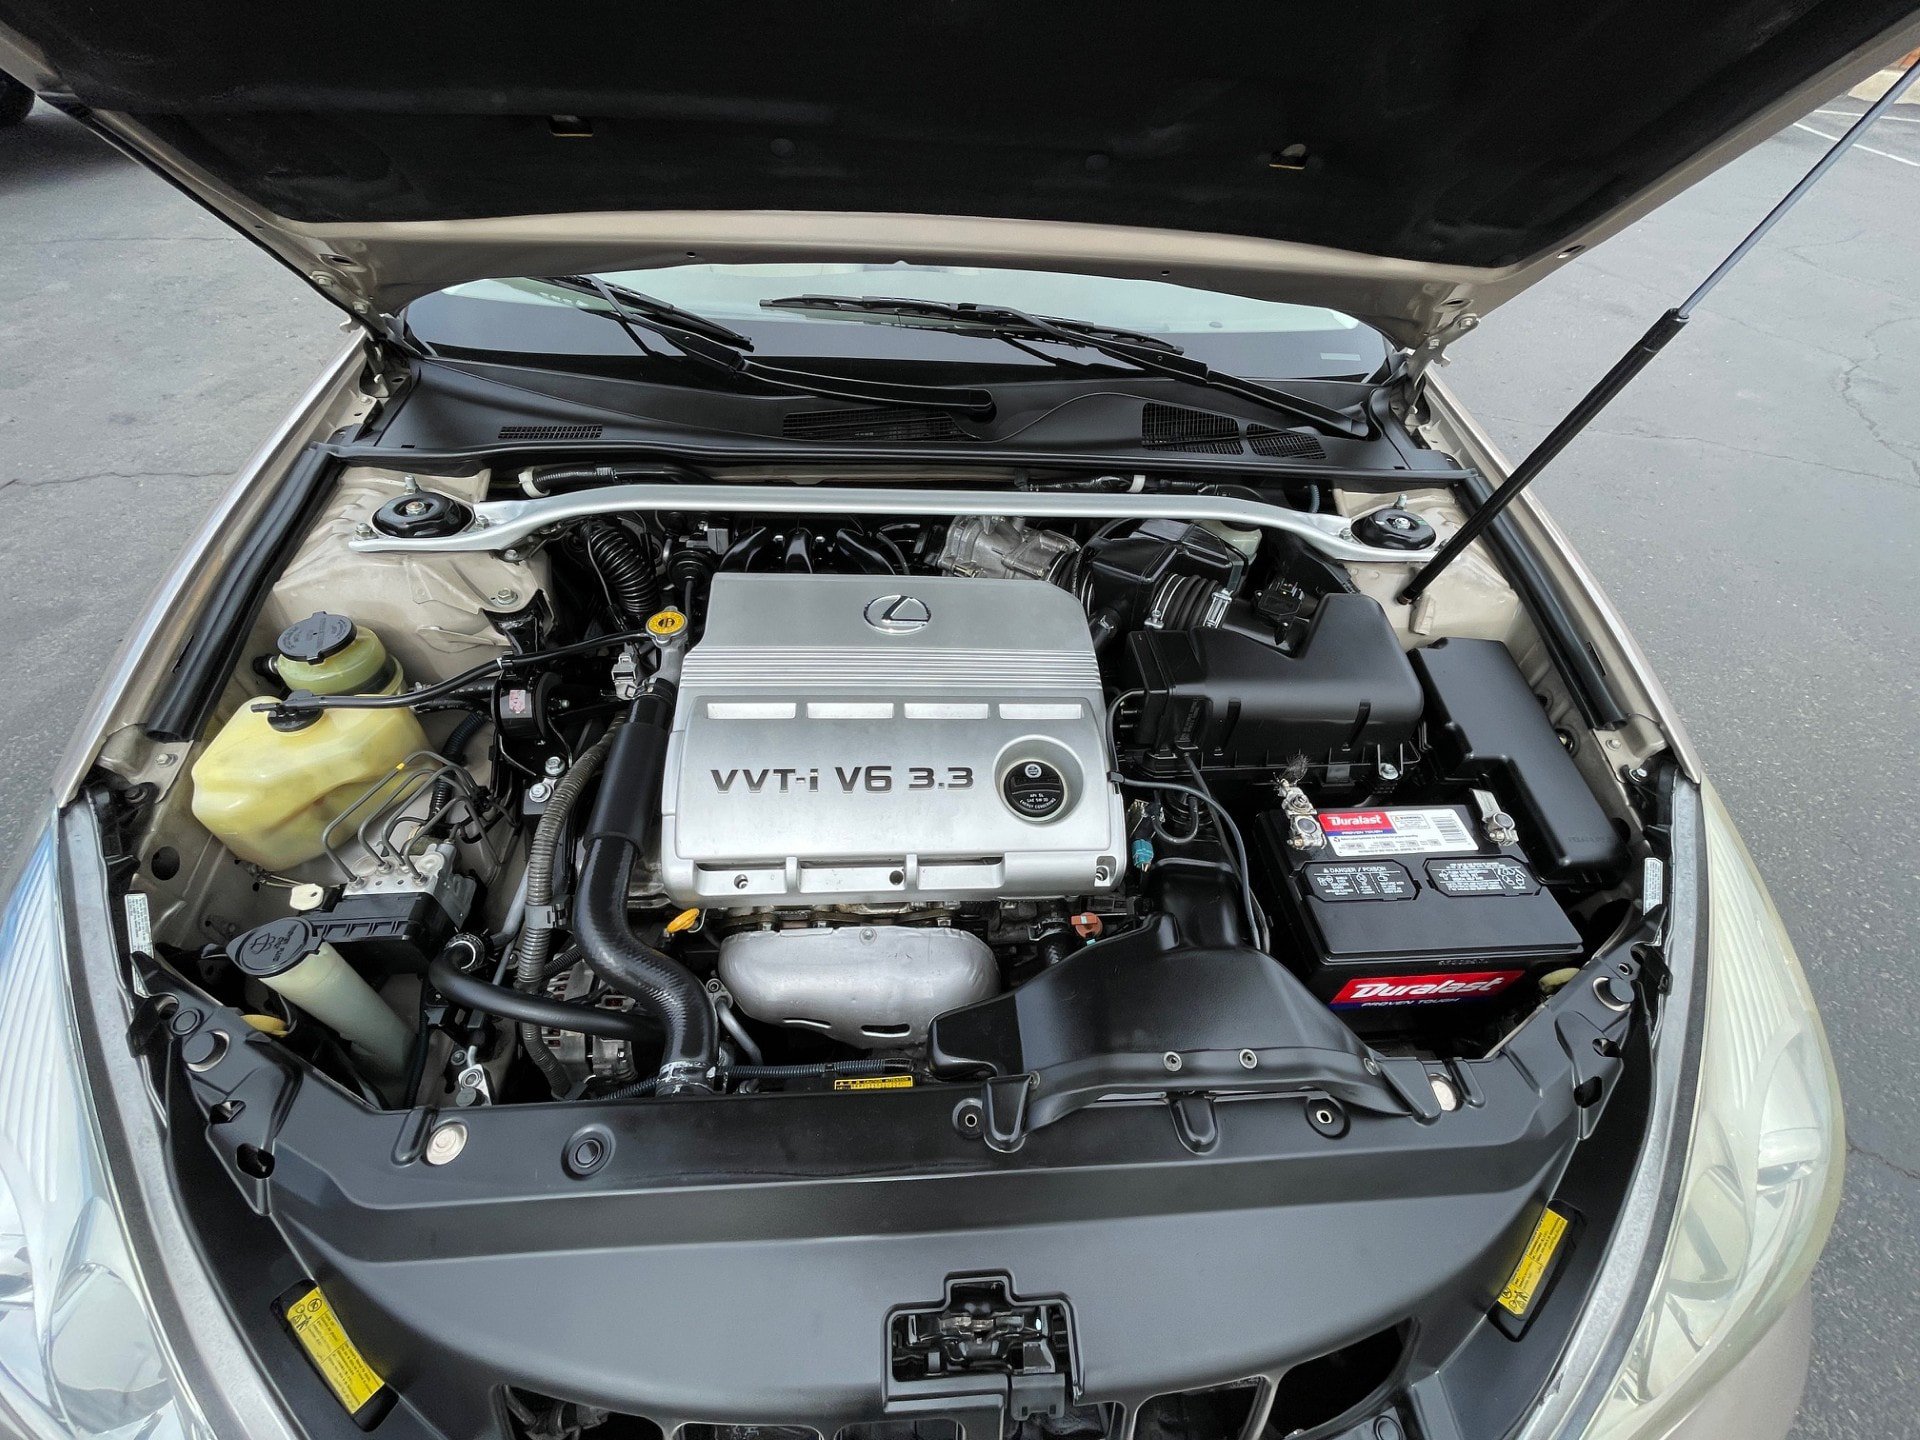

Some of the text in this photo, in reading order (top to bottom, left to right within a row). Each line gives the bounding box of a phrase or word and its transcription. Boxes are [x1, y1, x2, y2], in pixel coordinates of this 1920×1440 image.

[710, 764, 974, 794] VVT-i V6 3.3
[1328, 814, 1382, 826] Duralast
[1350, 977, 1504, 999] Duralast
[1418, 997, 1461, 1005] TOUGH
